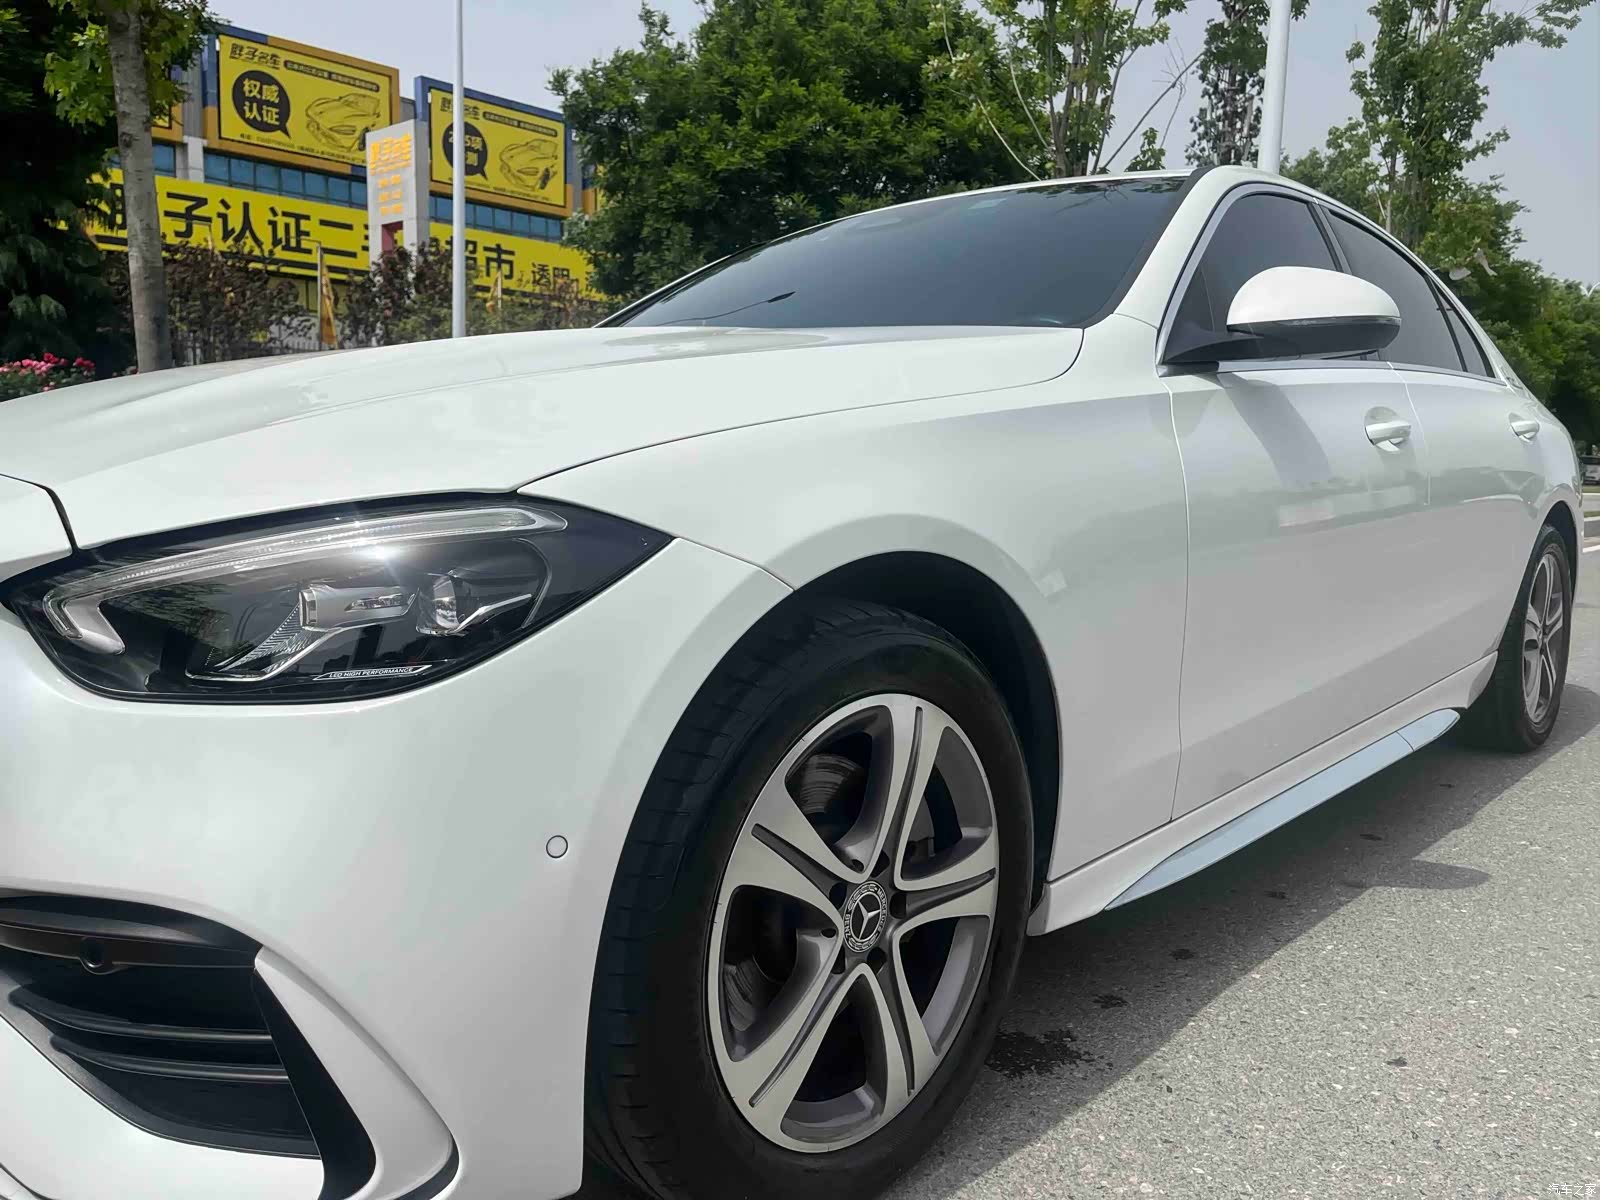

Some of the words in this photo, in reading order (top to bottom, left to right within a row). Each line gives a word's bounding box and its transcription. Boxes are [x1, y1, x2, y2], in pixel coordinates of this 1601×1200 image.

[243, 78, 280, 103] 权威
[243, 101, 280, 125] 认证
[448, 131, 483, 151] 25项
[361, 667, 413, 676] PERFORMANCE
[844, 913, 852, 939] BENZ
